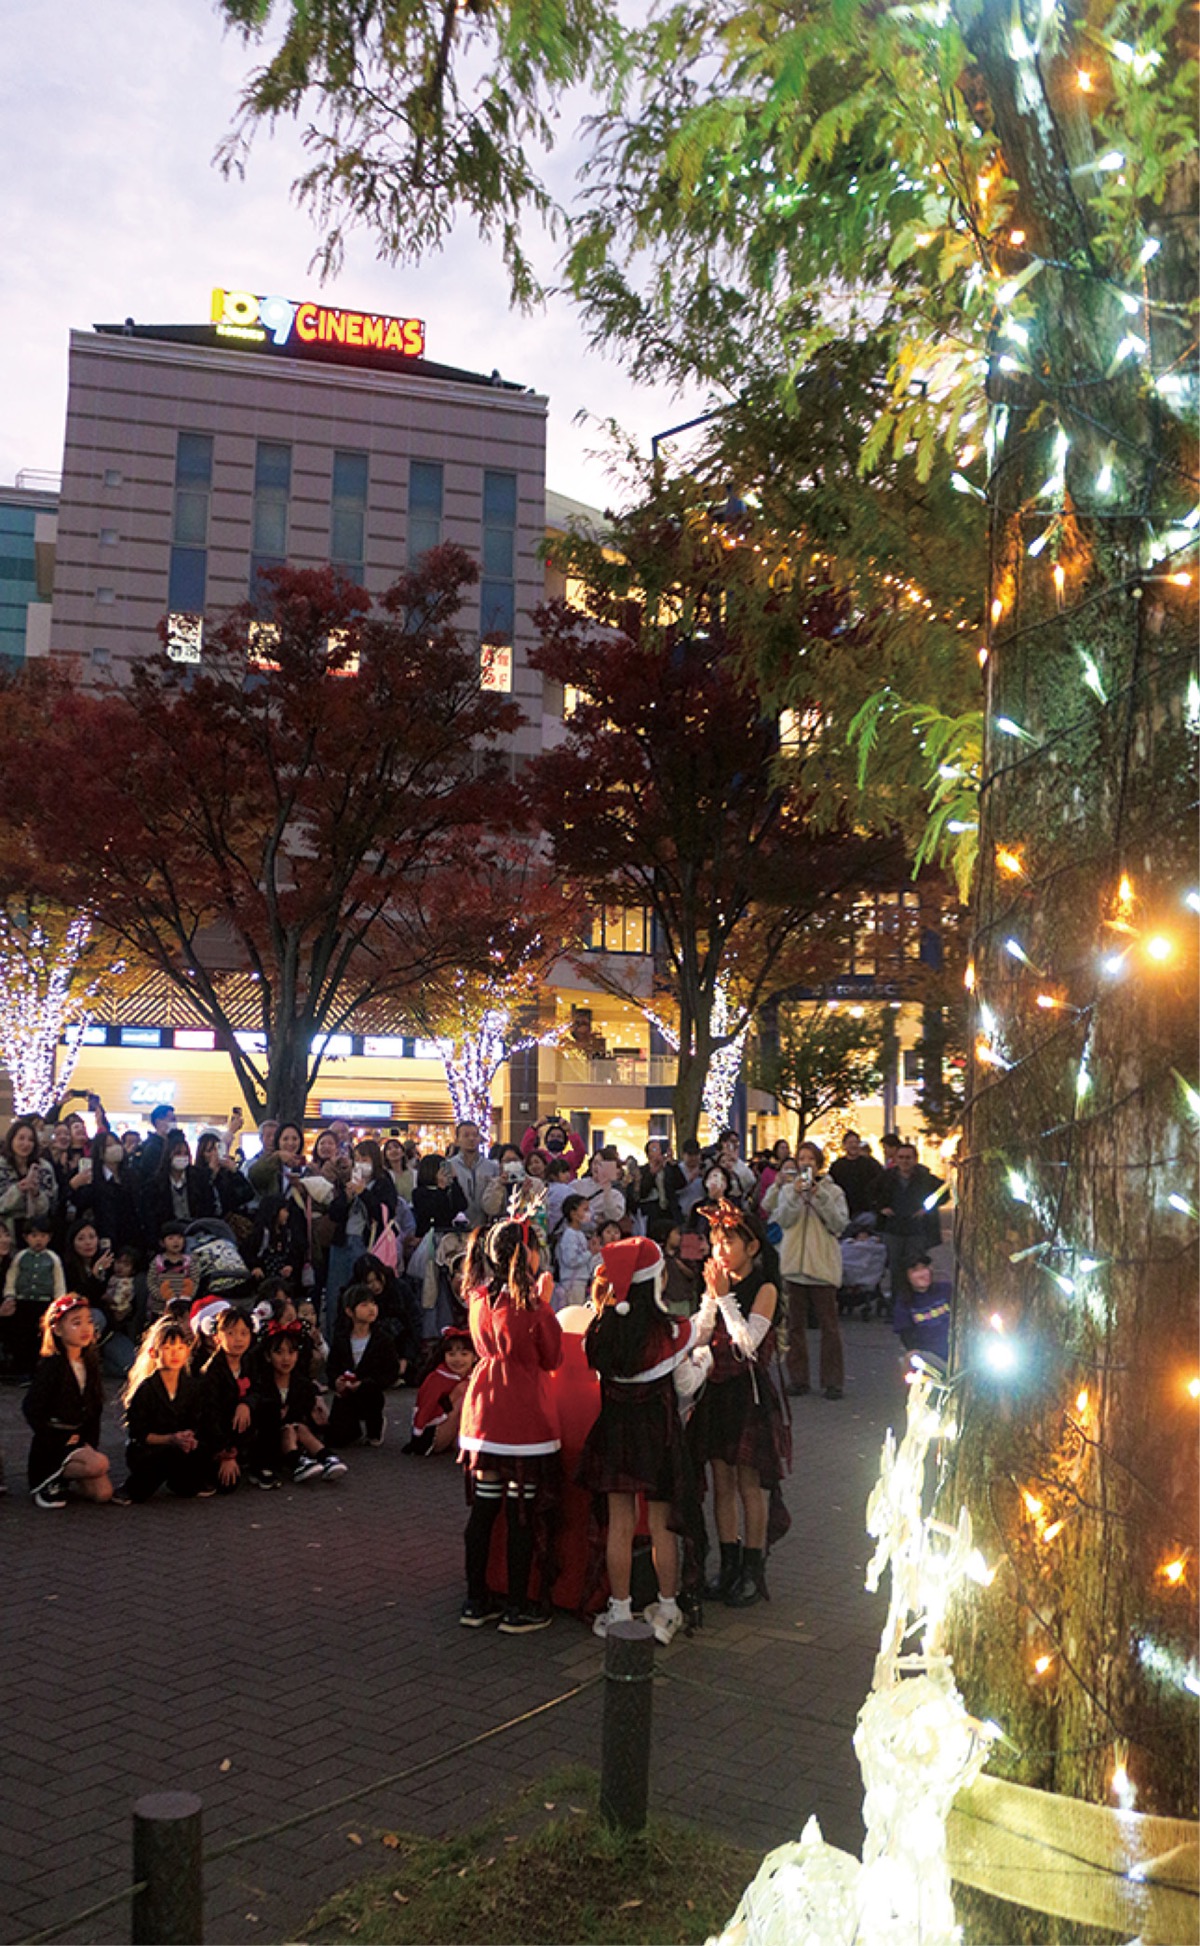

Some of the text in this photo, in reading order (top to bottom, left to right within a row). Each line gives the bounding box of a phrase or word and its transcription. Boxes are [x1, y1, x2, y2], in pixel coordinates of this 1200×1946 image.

[211, 287, 423, 354] 109 CINEMAS
[130, 1079, 175, 1103] Zoff
